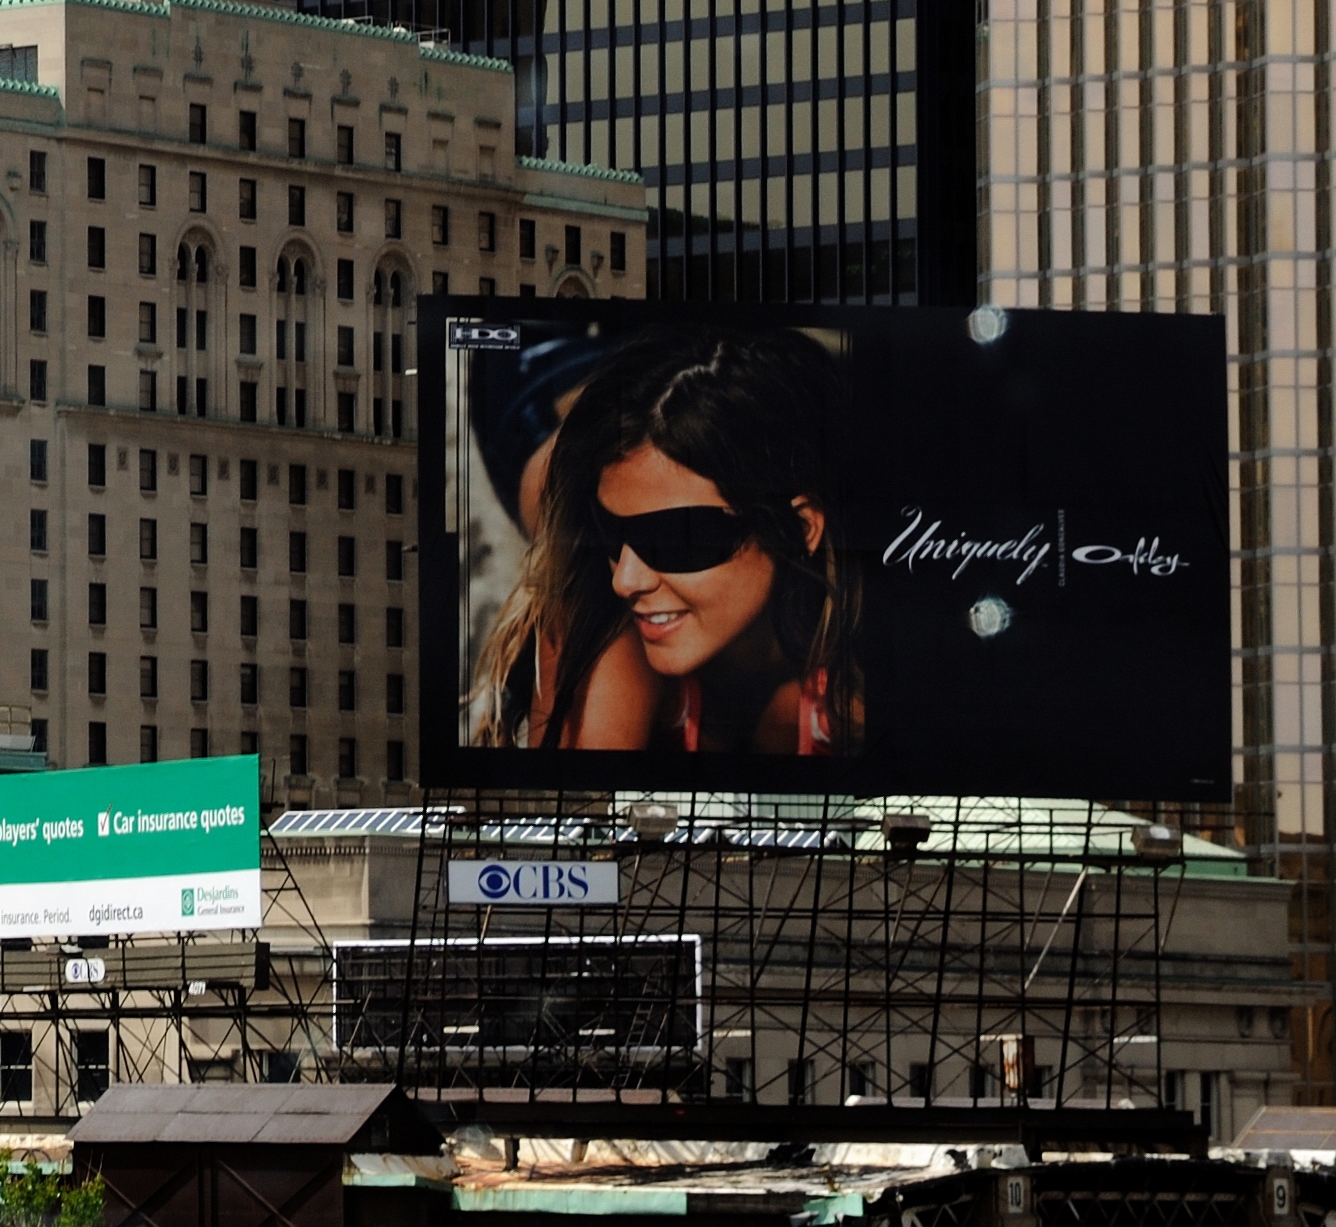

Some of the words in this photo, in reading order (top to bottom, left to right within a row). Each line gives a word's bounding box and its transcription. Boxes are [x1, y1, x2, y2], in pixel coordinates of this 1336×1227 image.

[455, 327, 518, 341] HDO
[882, 505, 1051, 585] Uniquely
[42, 816, 84, 846] quotes
[113, 811, 135, 835] Car
[138, 809, 198, 833] insurance
[200, 804, 245, 834] quotes
[197, 885, 239, 904] Desjardins
[513, 864, 589, 900] CBS
[1, 910, 41, 925] insurance.
[43, 907, 72, 924] Period.
[89, 904, 143, 926] dgidirect.ca
[1009, 1181, 1021, 1207] 10
[1276, 1184, 1286, 1209] 9
